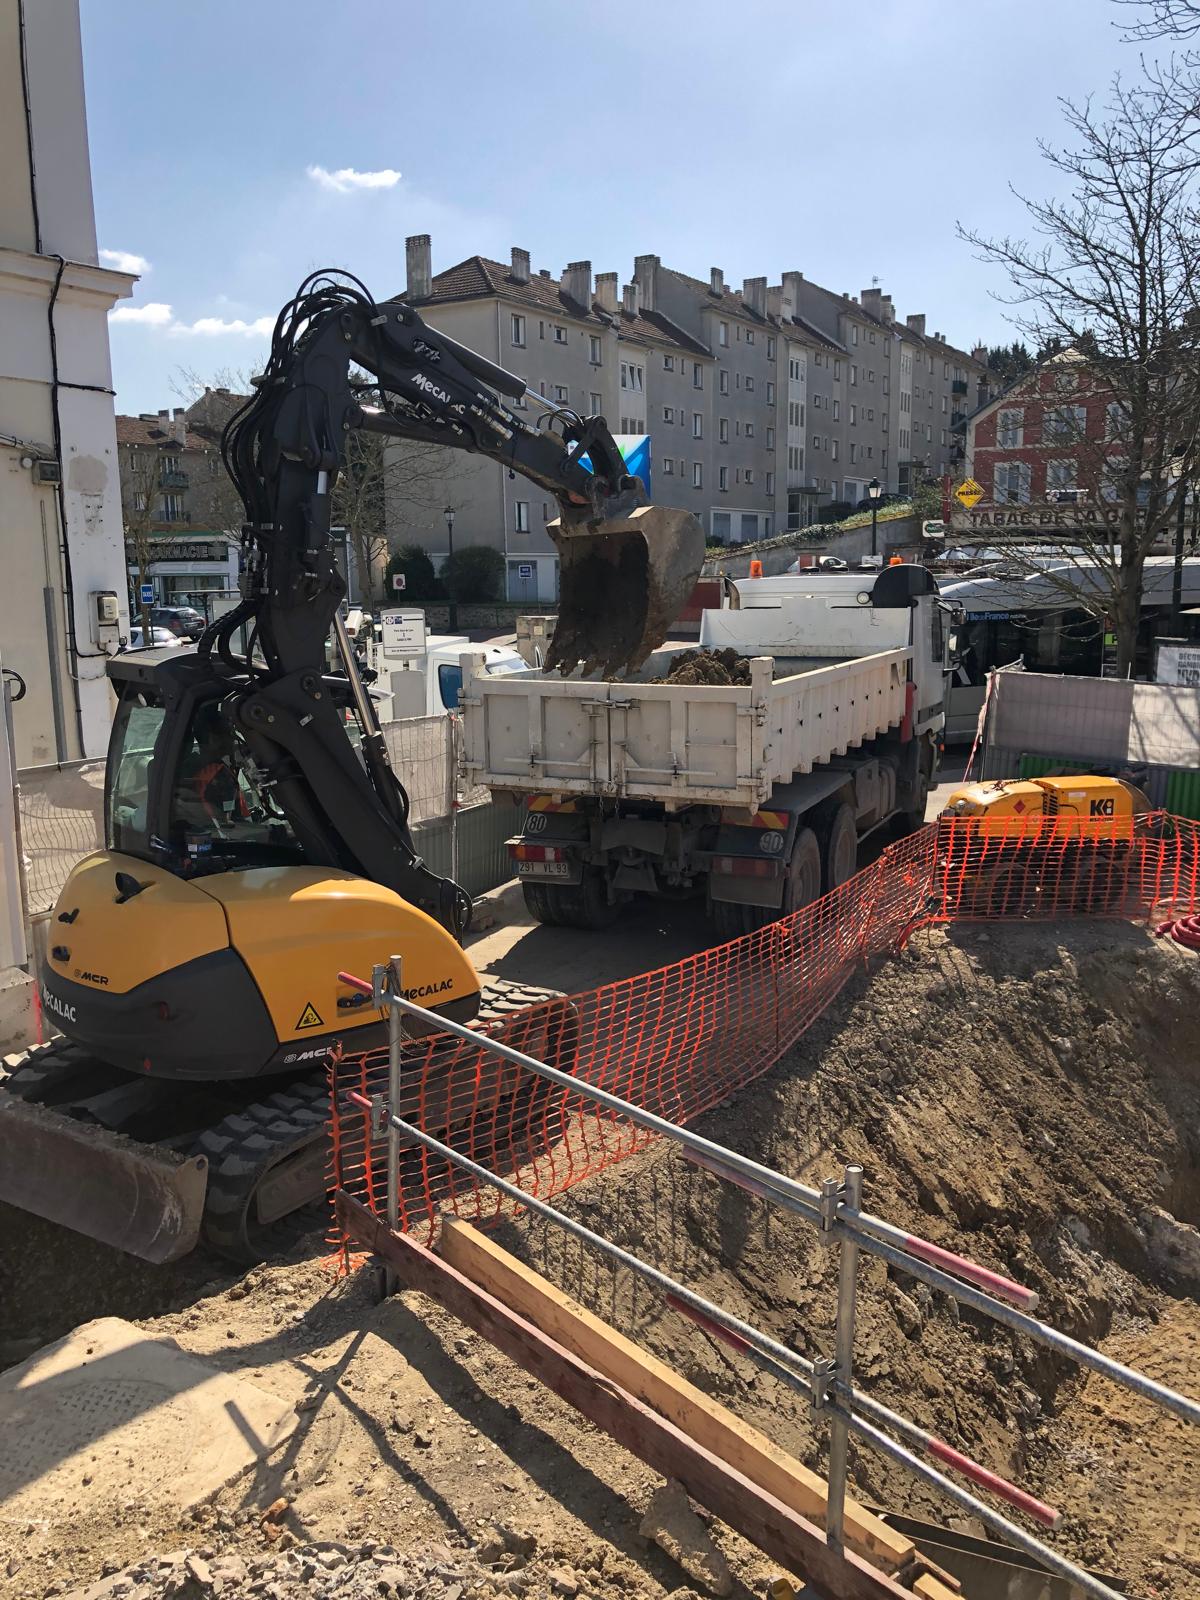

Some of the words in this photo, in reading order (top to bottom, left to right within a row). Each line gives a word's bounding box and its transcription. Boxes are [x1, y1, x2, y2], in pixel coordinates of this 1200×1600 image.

[969, 511, 1032, 527] TABAC
[528, 815, 547, 832] 80
[763, 832, 782, 850] 90
[519, 862, 535, 872] 291
[543, 863, 554, 873] VL
[556, 863, 567, 873] 93
